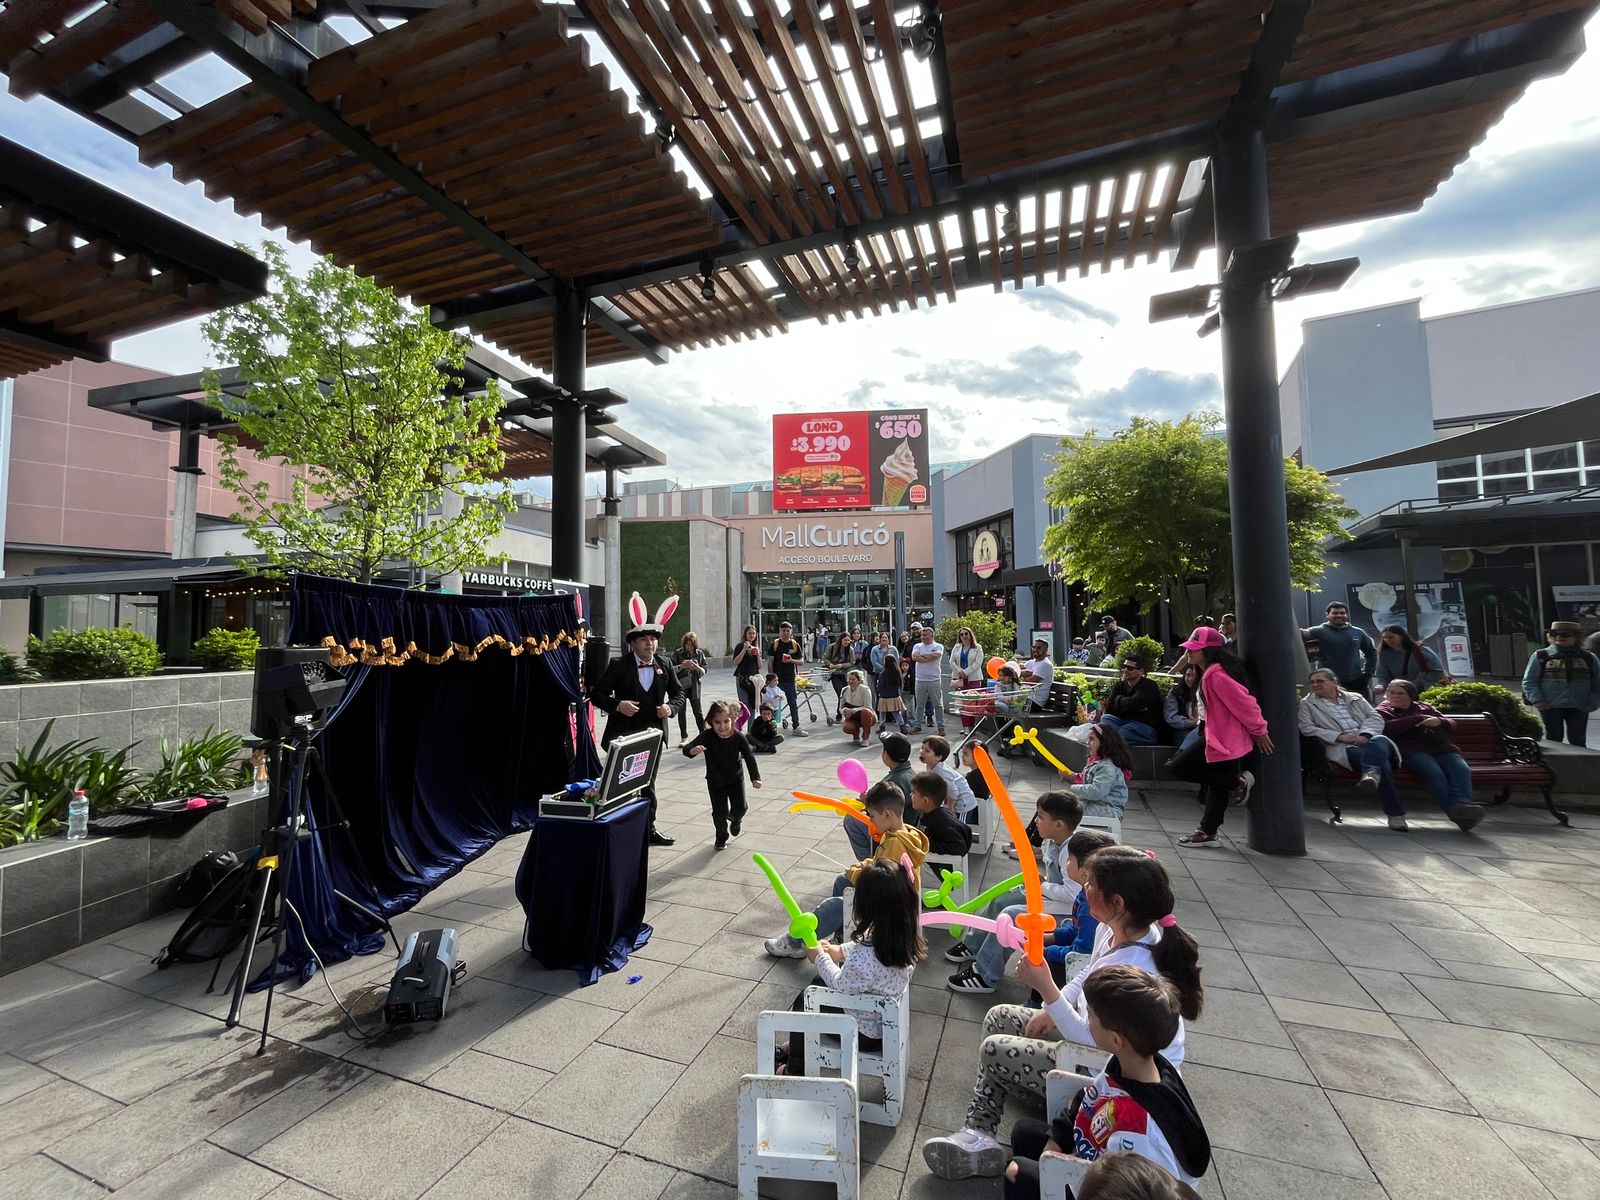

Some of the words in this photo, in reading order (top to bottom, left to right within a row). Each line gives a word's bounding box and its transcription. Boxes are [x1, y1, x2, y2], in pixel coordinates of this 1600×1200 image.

[806, 422, 838, 433] LONG
[875, 420, 922, 438] $650
[791, 435, 851, 453] $3.990
[762, 523, 890, 548] MallCuricó
[778, 555, 816, 564] ACCESO
[818, 554, 873, 564] BOULEVARD
[464, 572, 523, 588] TARBUCKS
[524, 578, 552, 591] COFFE
